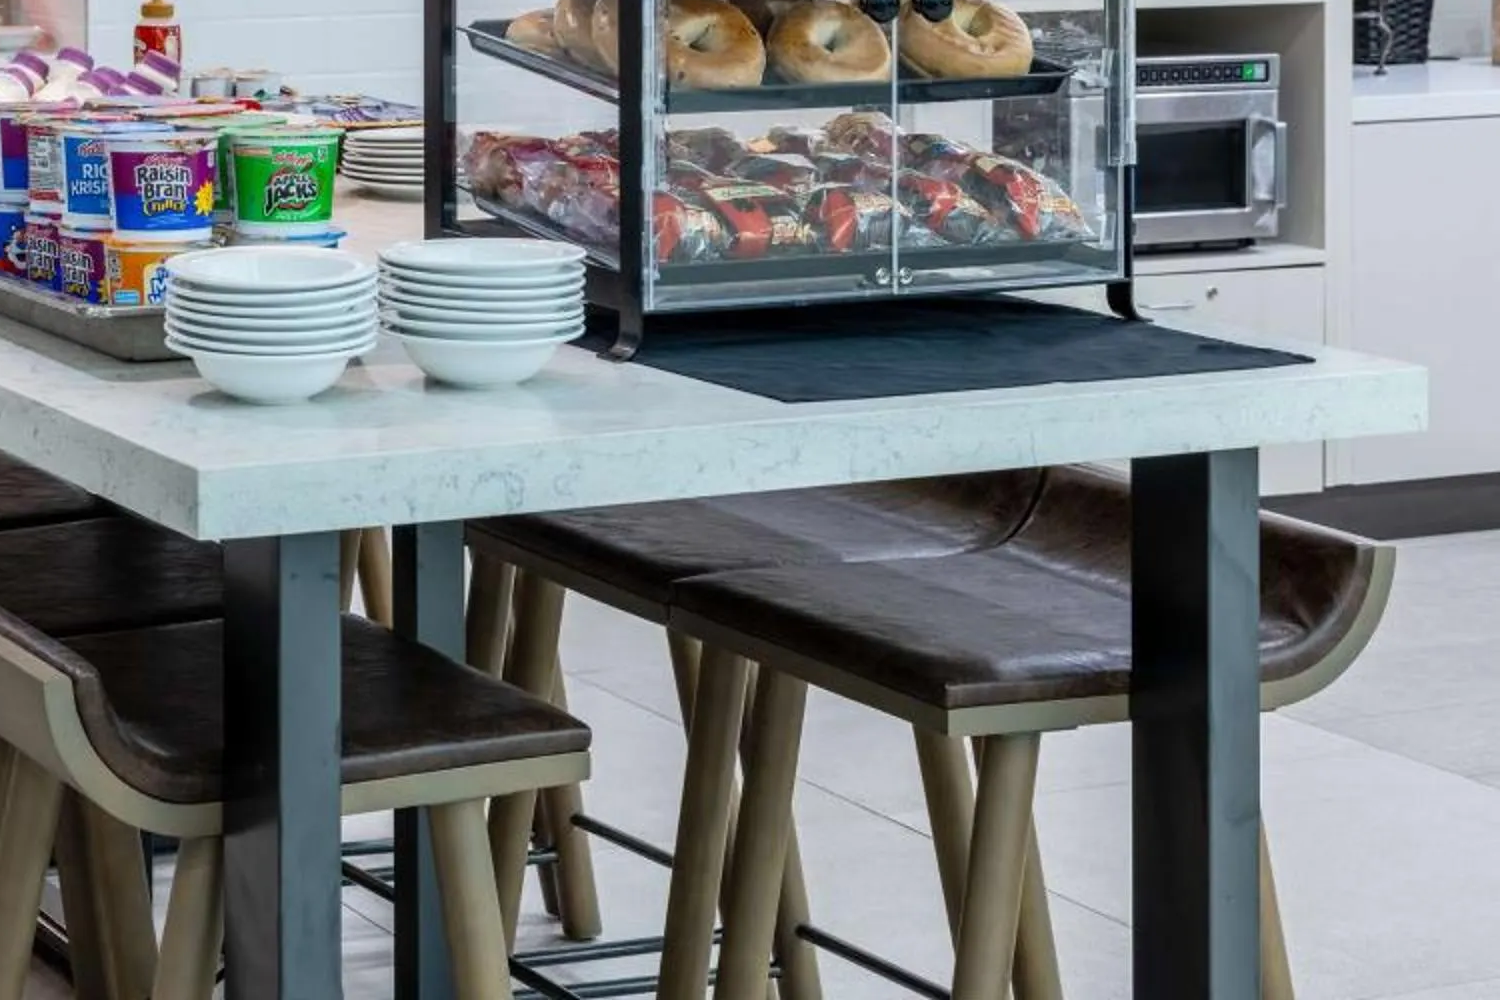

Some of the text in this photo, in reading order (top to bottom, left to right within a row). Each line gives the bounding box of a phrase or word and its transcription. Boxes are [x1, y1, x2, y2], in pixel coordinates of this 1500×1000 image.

[82, 162, 109, 180] RIC
[134, 163, 192, 186] Raisin
[70, 180, 109, 197] KRISP
[142, 182, 187, 201] Bran
[263, 181, 318, 216] JACKS
[28, 236, 59, 258] aisin
[61, 250, 94, 273] aisin
